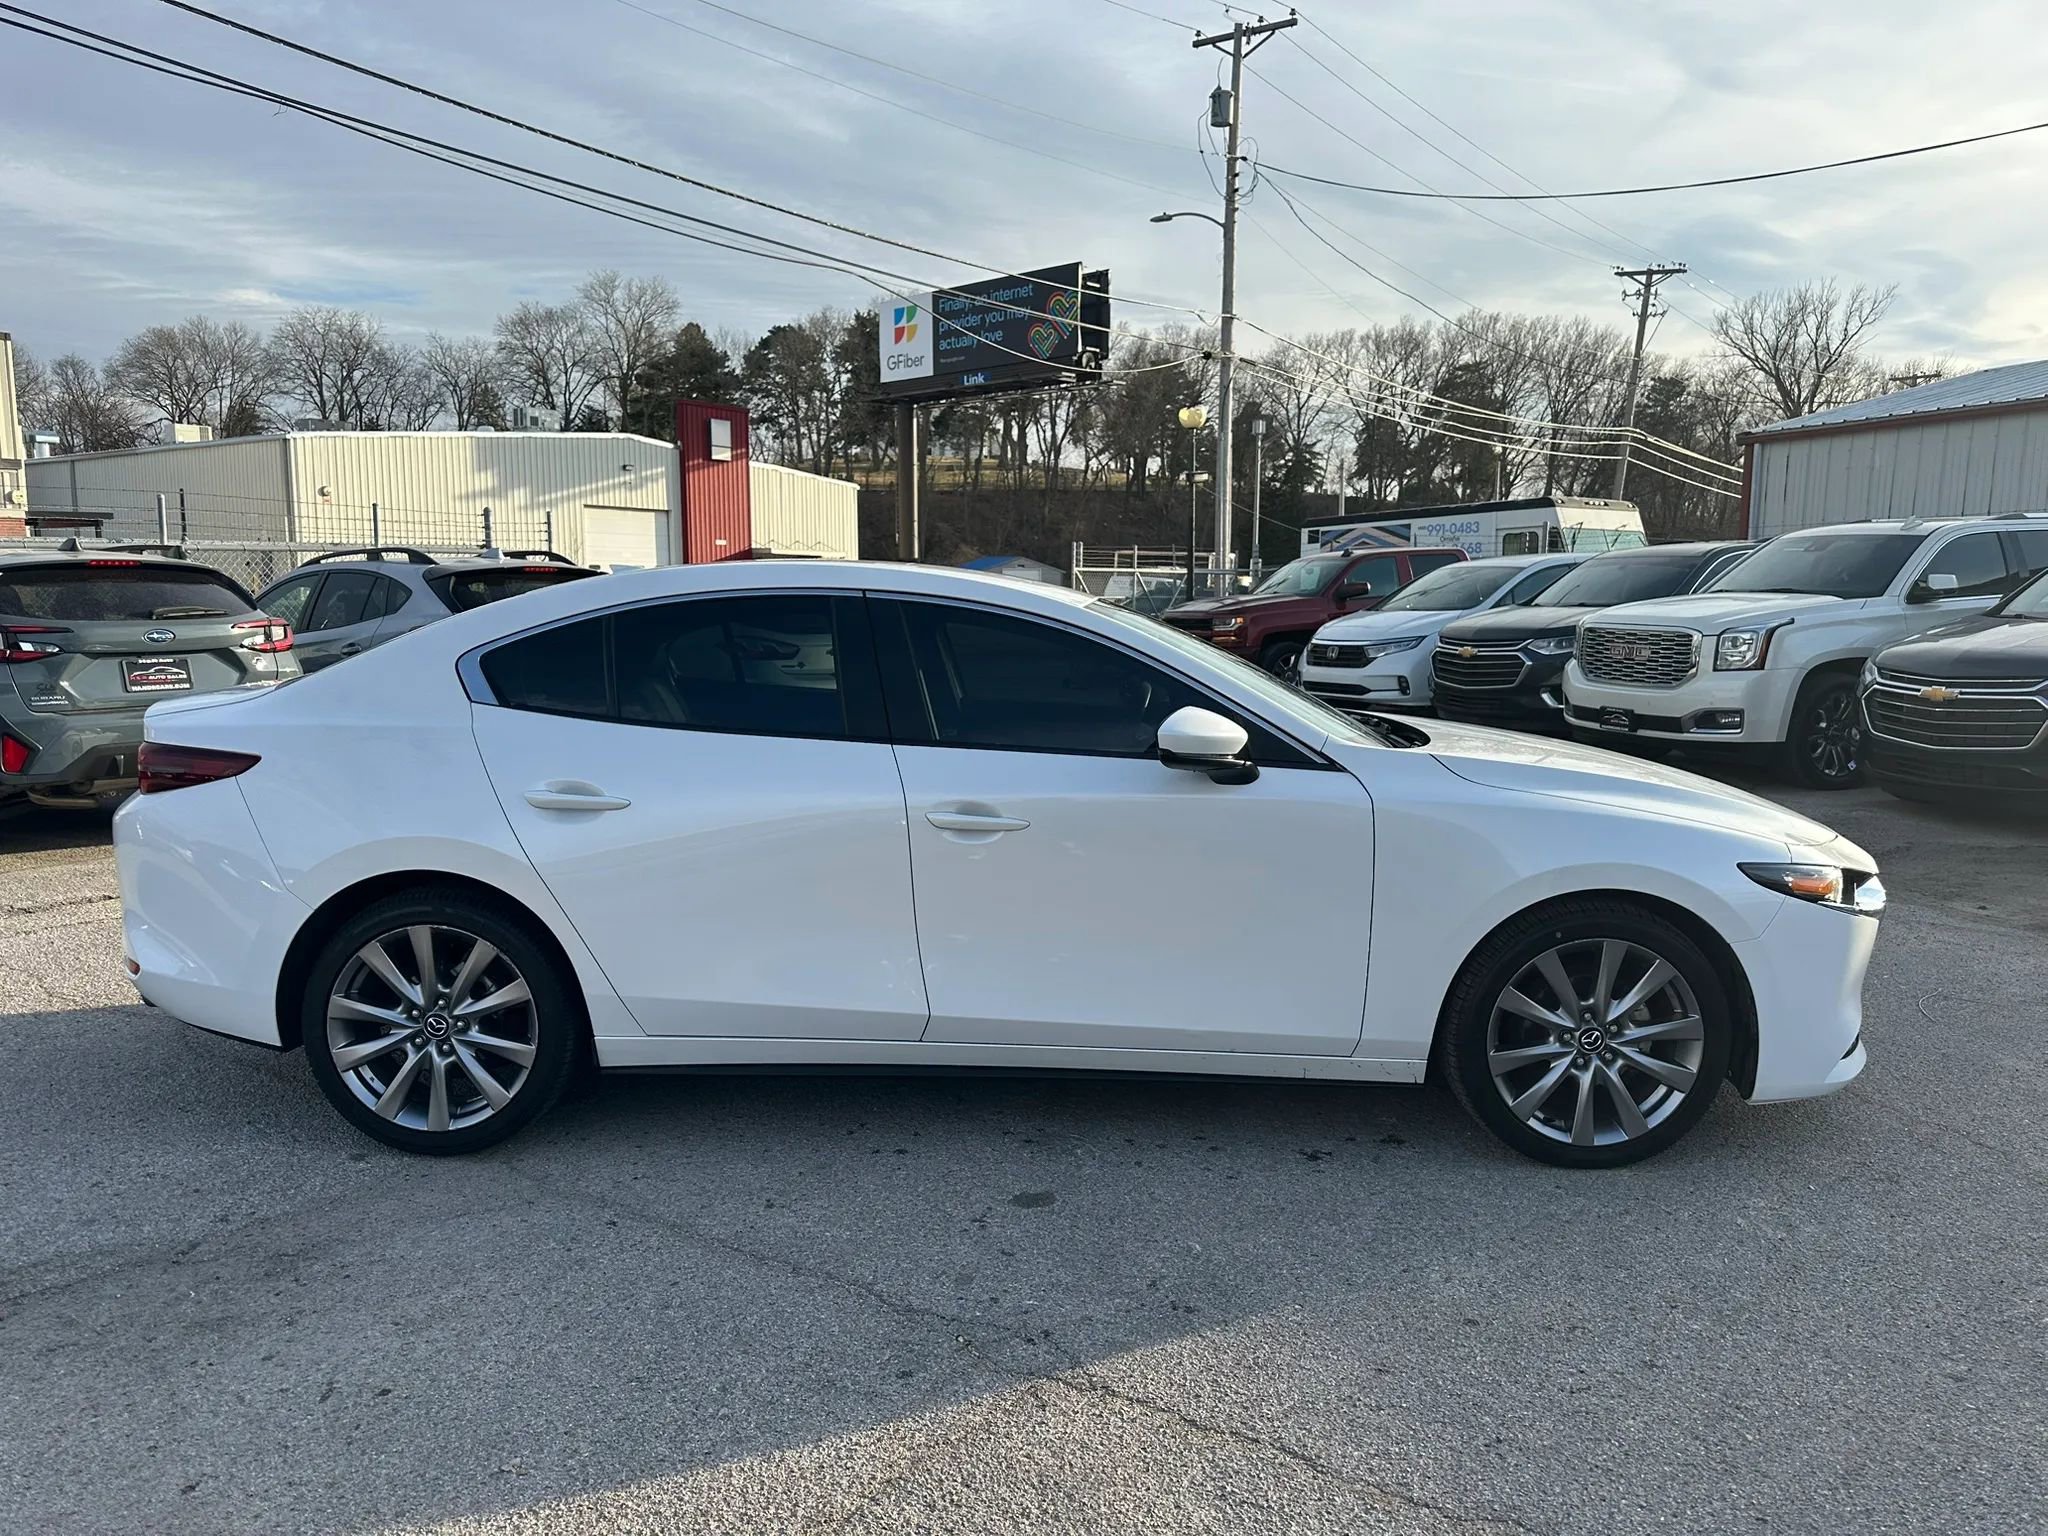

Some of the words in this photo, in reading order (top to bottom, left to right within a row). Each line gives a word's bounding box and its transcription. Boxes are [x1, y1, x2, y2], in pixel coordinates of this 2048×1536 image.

[990, 284, 1034, 302] internet
[939, 314, 983, 335] provider
[985, 311, 1004, 327] you
[1007, 305, 1031, 321] may
[939, 334, 979, 351] actually
[981, 330, 1003, 343] love
[887, 352, 925, 371] GFiber
[963, 372, 985, 385] Link
[1427, 521, 1480, 536] 991-0483
[1610, 645, 1650, 659] GMC
